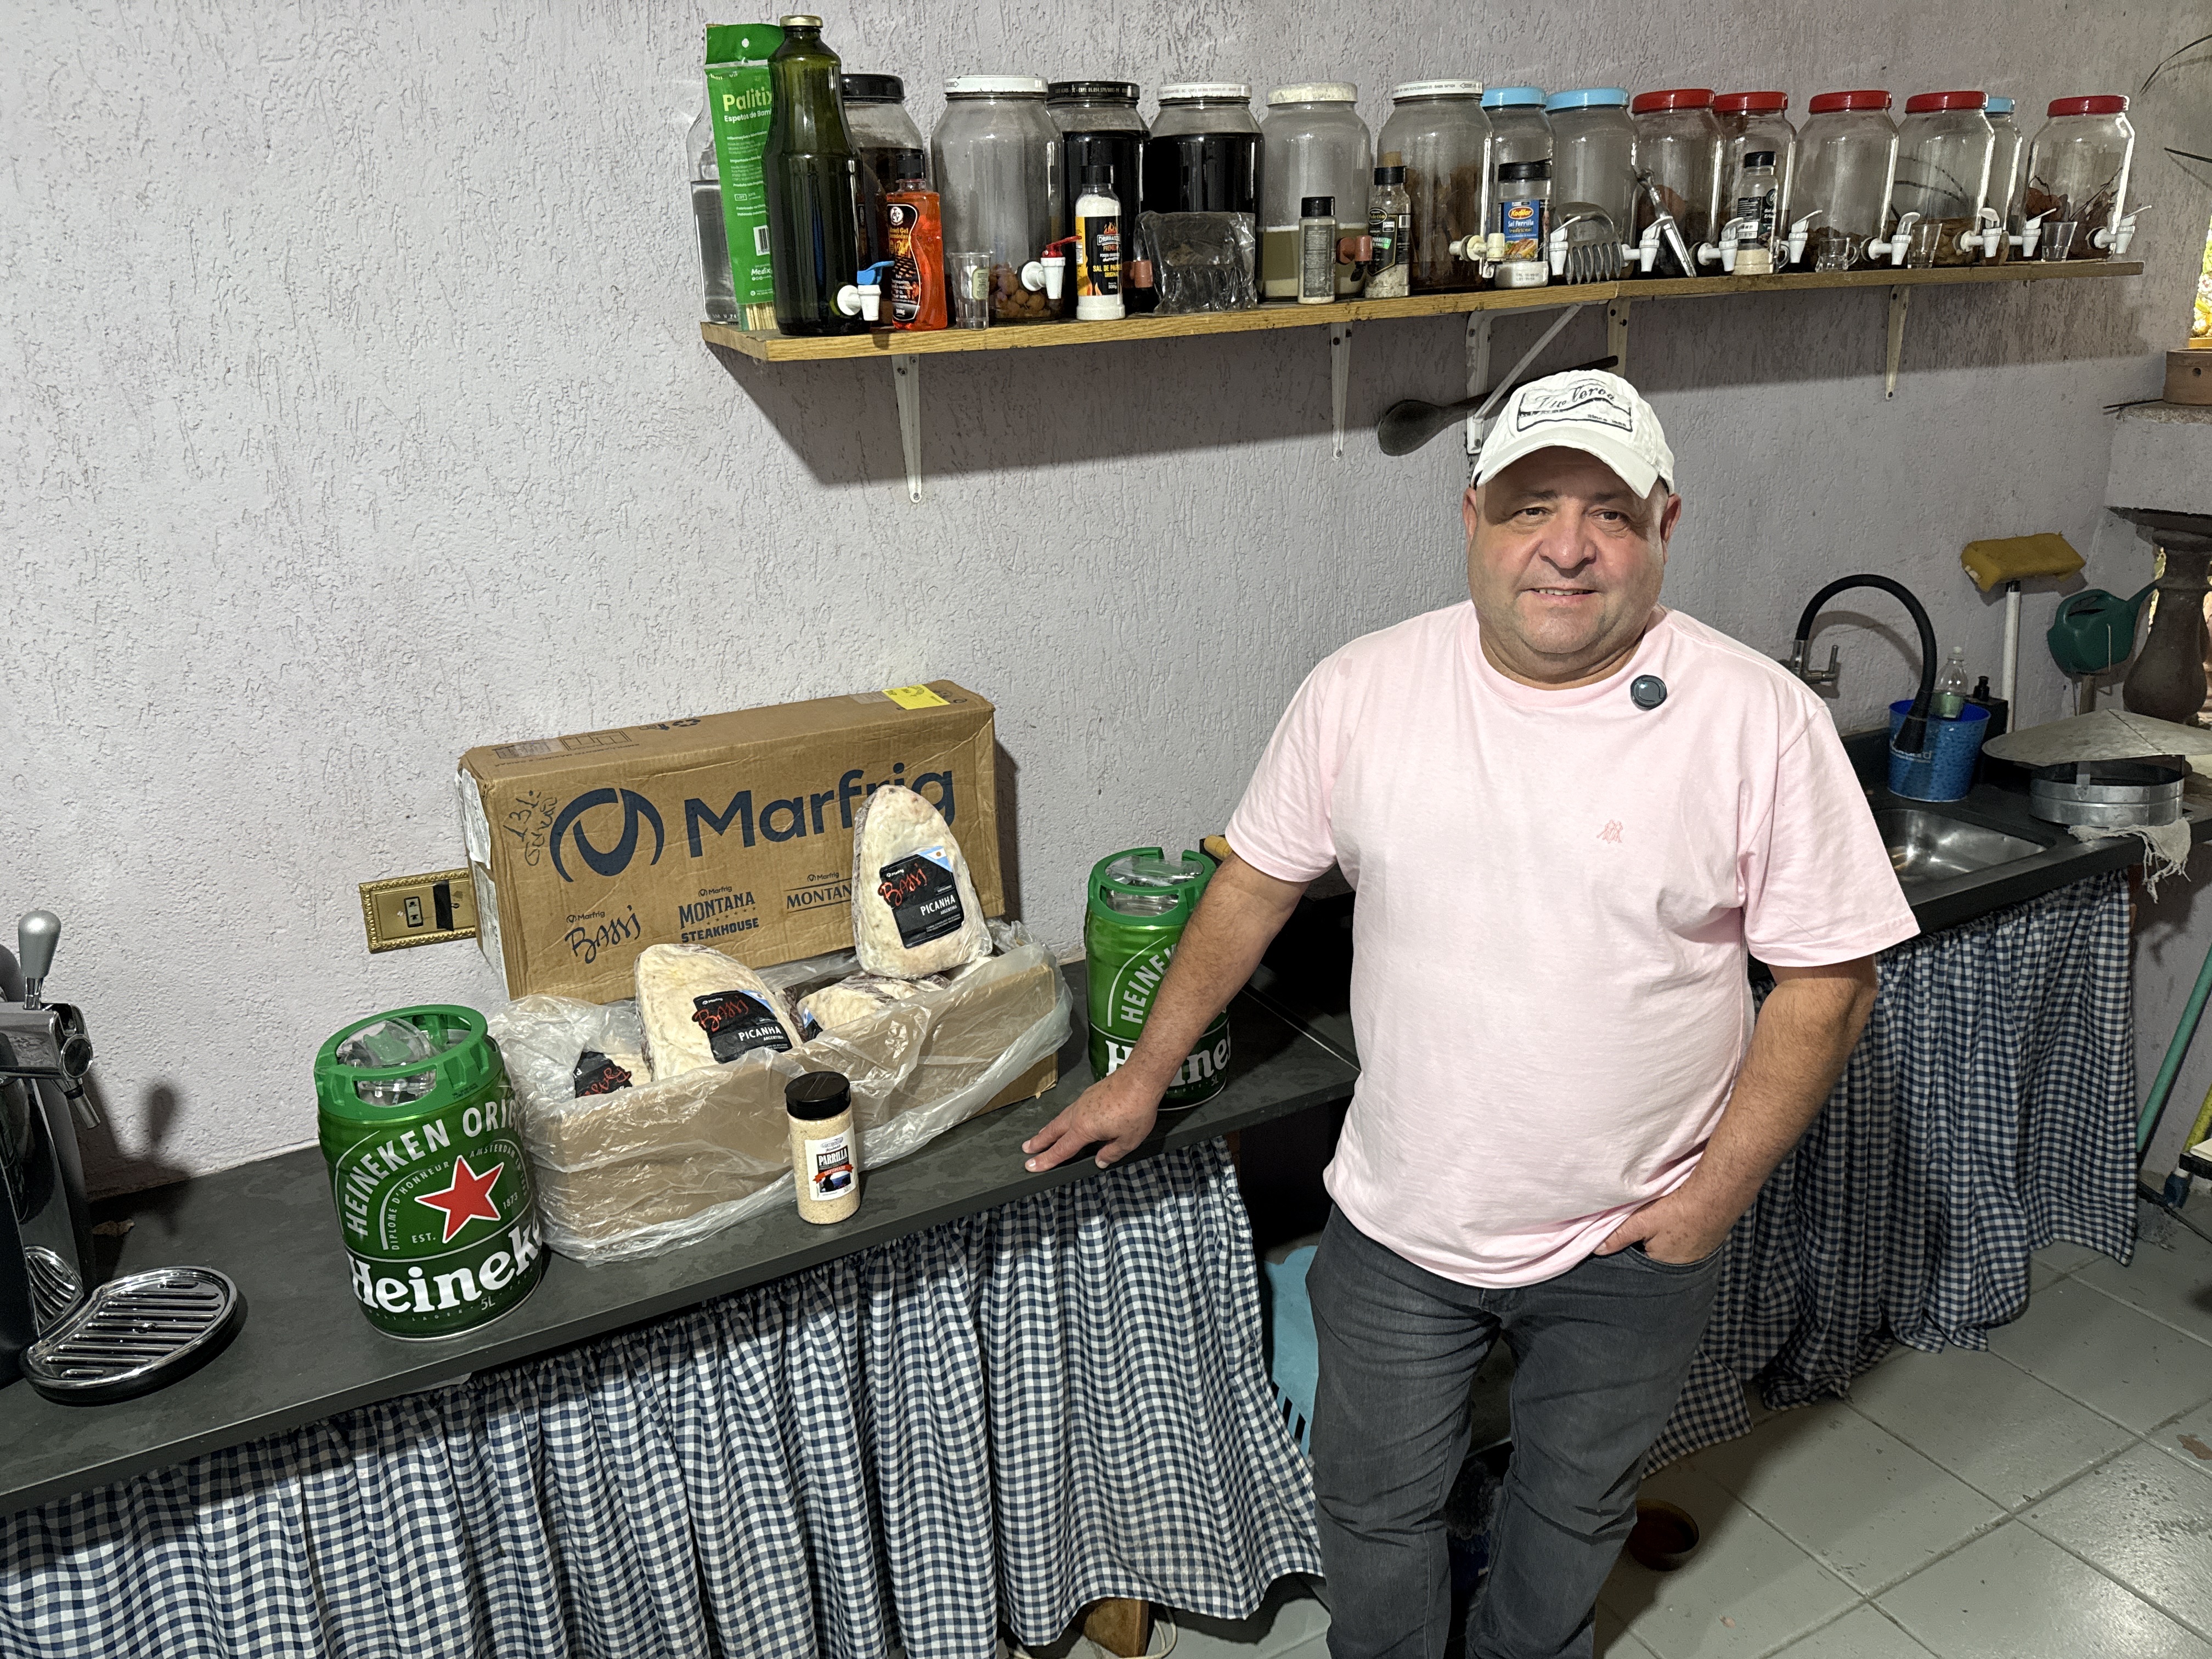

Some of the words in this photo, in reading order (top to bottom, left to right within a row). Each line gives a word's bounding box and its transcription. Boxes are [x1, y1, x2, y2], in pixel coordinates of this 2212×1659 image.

[724, 114, 749, 124] Espetos
[817, 872, 839, 881] Marfrig
[708, 885, 732, 895] Marfrig
[787, 883, 852, 910] MONTAN
[678, 891, 755, 930] MONTANA
[920, 894, 956, 916] PICANHA
[578, 911, 605, 921] Marfrig
[681, 917, 759, 943] STEAKHOUSE
[738, 1026, 782, 1041] PICANHA
[1211, 1076, 1219, 1087] 5L
[469, 1144, 515, 1159] AMSTERDAM
[818, 1148, 848, 1166] PARRILLA
[345, 1118, 452, 1237] HEINEKEN
[392, 1161, 450, 1204] D'HONNEUR
[412, 1232, 436, 1244] EST.
[502, 1192, 518, 1210] 1873
[387, 1207, 400, 1251] DIPLOME
[481, 1295, 496, 1311] 5L
